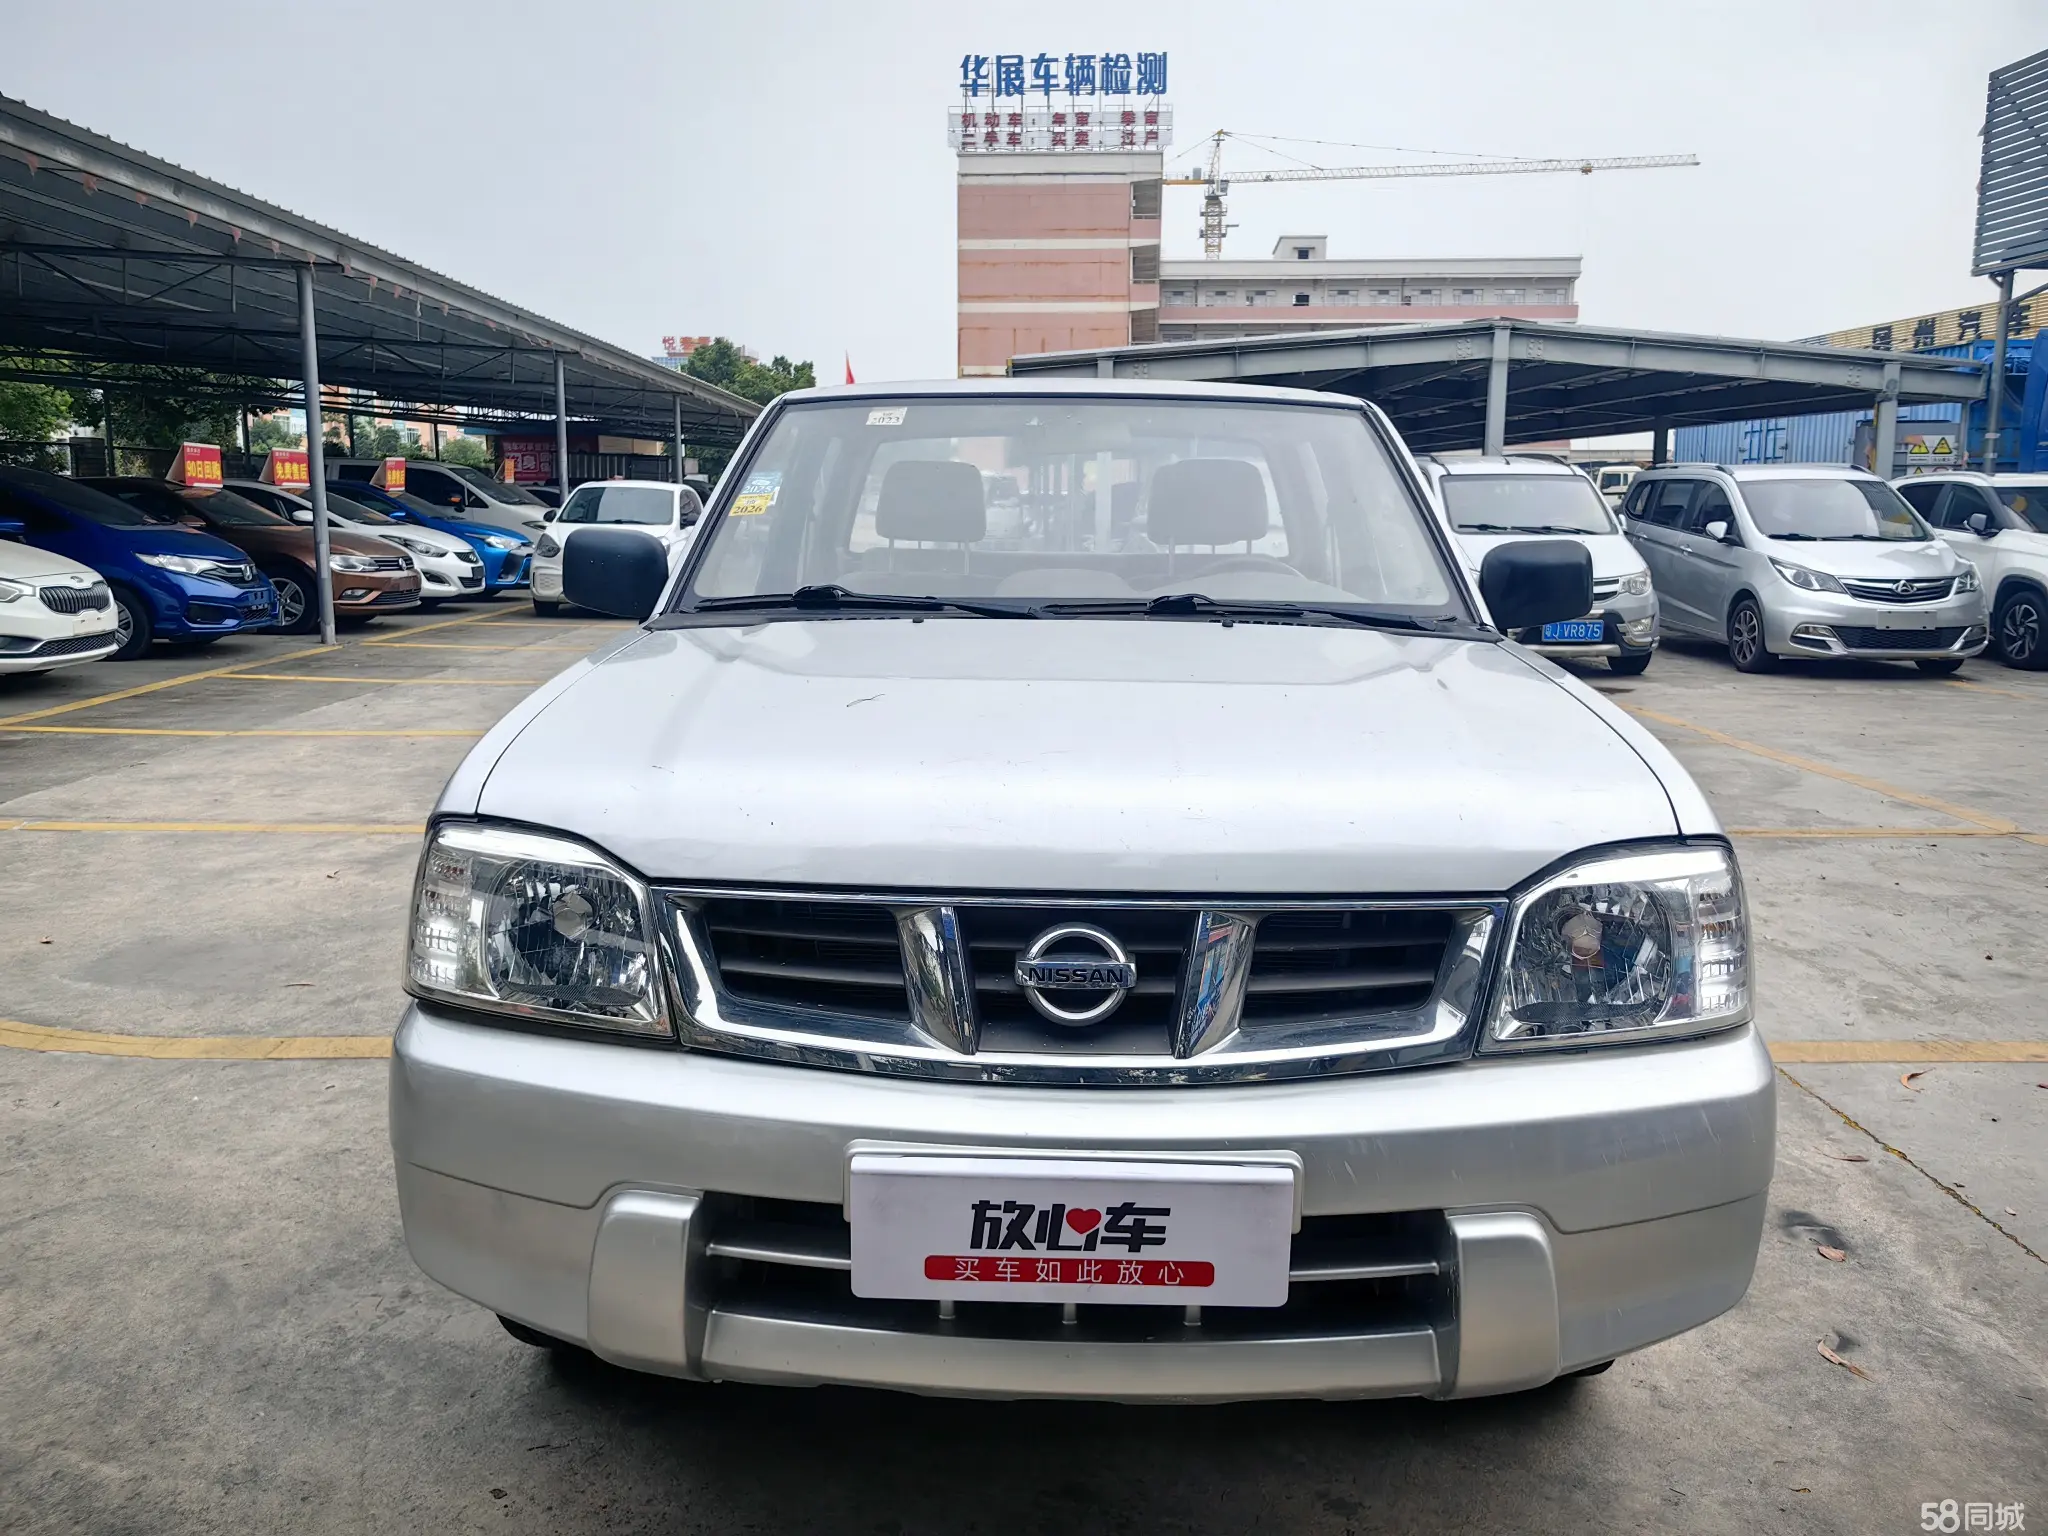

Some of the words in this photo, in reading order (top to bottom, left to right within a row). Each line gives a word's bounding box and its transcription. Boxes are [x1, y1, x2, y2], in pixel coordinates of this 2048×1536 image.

[960, 51, 1168, 97] 华展车辆检测
[186, 460, 221, 480] 90日回购
[275, 461, 308, 480] 免费售后
[732, 505, 763, 514] 2026
[1028, 967, 1124, 983] NISSAN
[969, 1199, 1171, 1253] 放心车
[953, 1257, 1185, 1285] 买车如此放心
